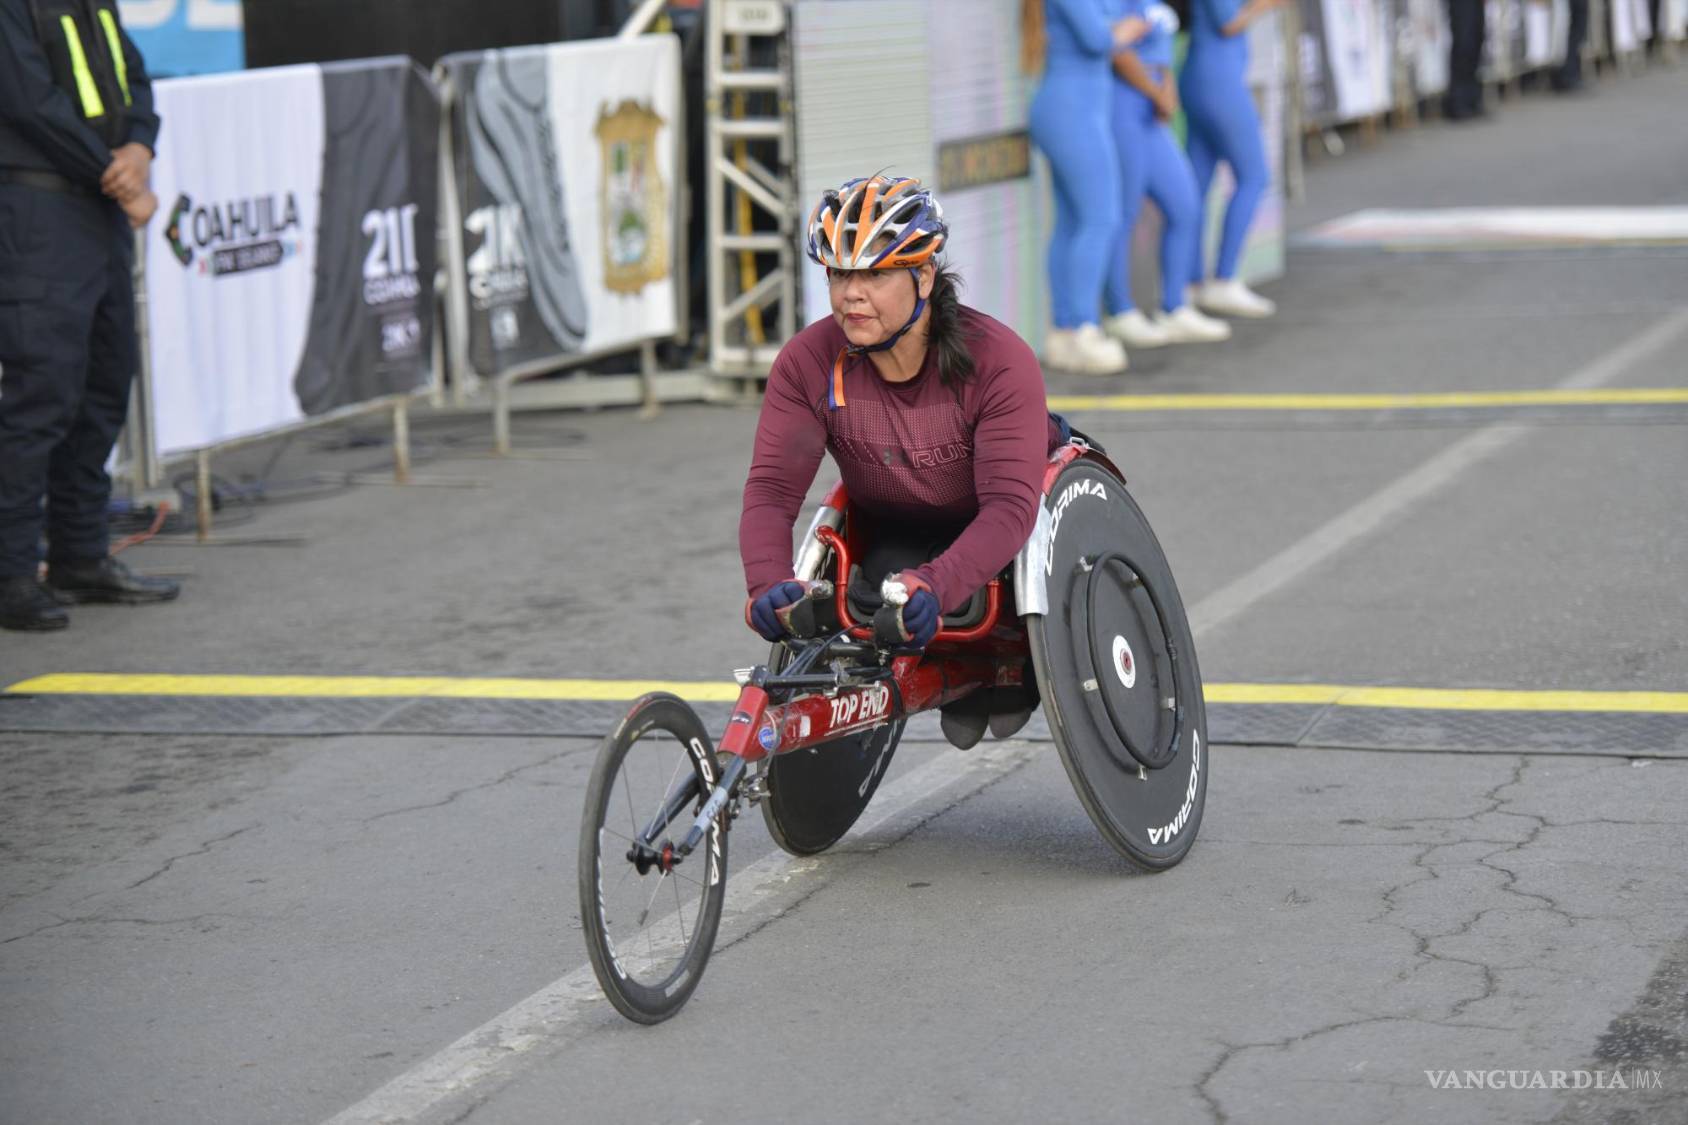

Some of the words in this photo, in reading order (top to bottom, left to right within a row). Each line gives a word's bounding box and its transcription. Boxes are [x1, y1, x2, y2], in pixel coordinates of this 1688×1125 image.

[164, 192, 299, 266] COAHUILA
[1045, 479, 1107, 576] CORIMA
[830, 698, 858, 728] TOP
[859, 685, 889, 720] END
[690, 737, 720, 886] COMA
[1147, 728, 1200, 844] CORIMA
